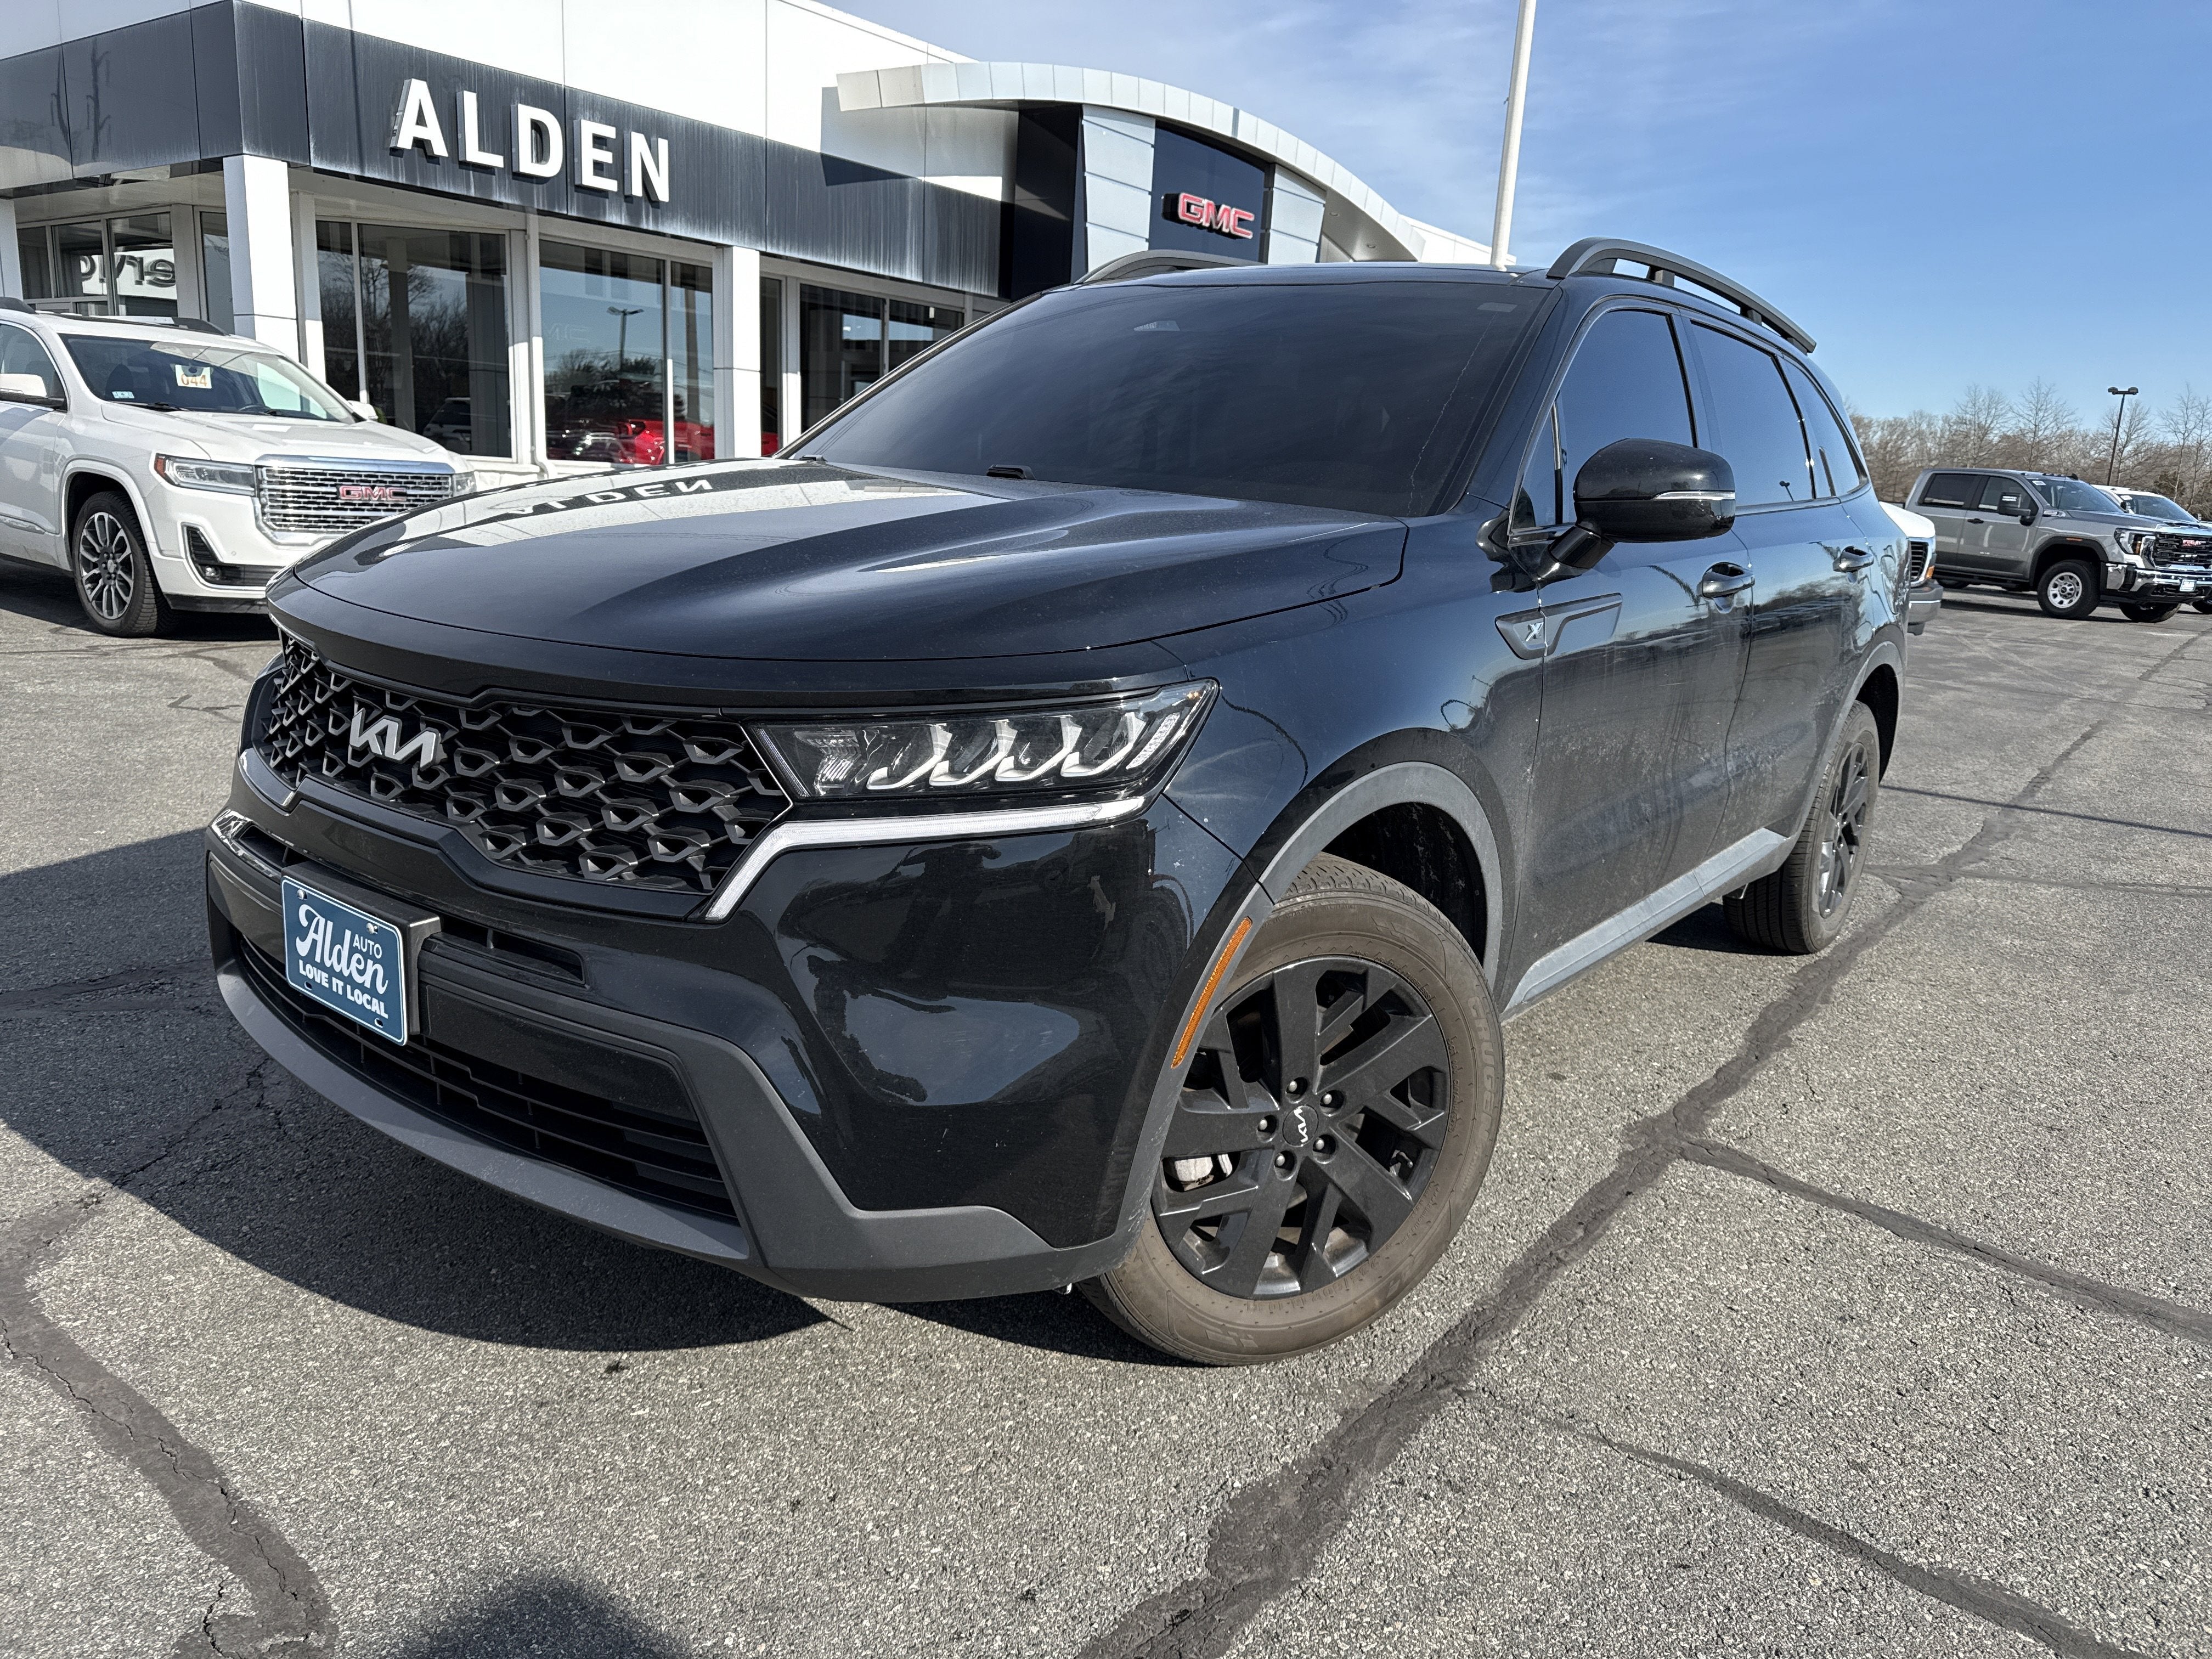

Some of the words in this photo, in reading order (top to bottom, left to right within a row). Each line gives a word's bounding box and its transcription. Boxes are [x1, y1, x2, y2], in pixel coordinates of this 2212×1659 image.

[390, 78, 669, 202] ALDEN
[1178, 192, 1255, 239] GMC
[339, 485, 407, 501] GMC
[296, 904, 388, 995] Alden
[353, 934, 382, 959] AUTO
[298, 959, 329, 988] LOVE
[331, 977, 344, 995] IT
[346, 989, 388, 1019] LOCAL
